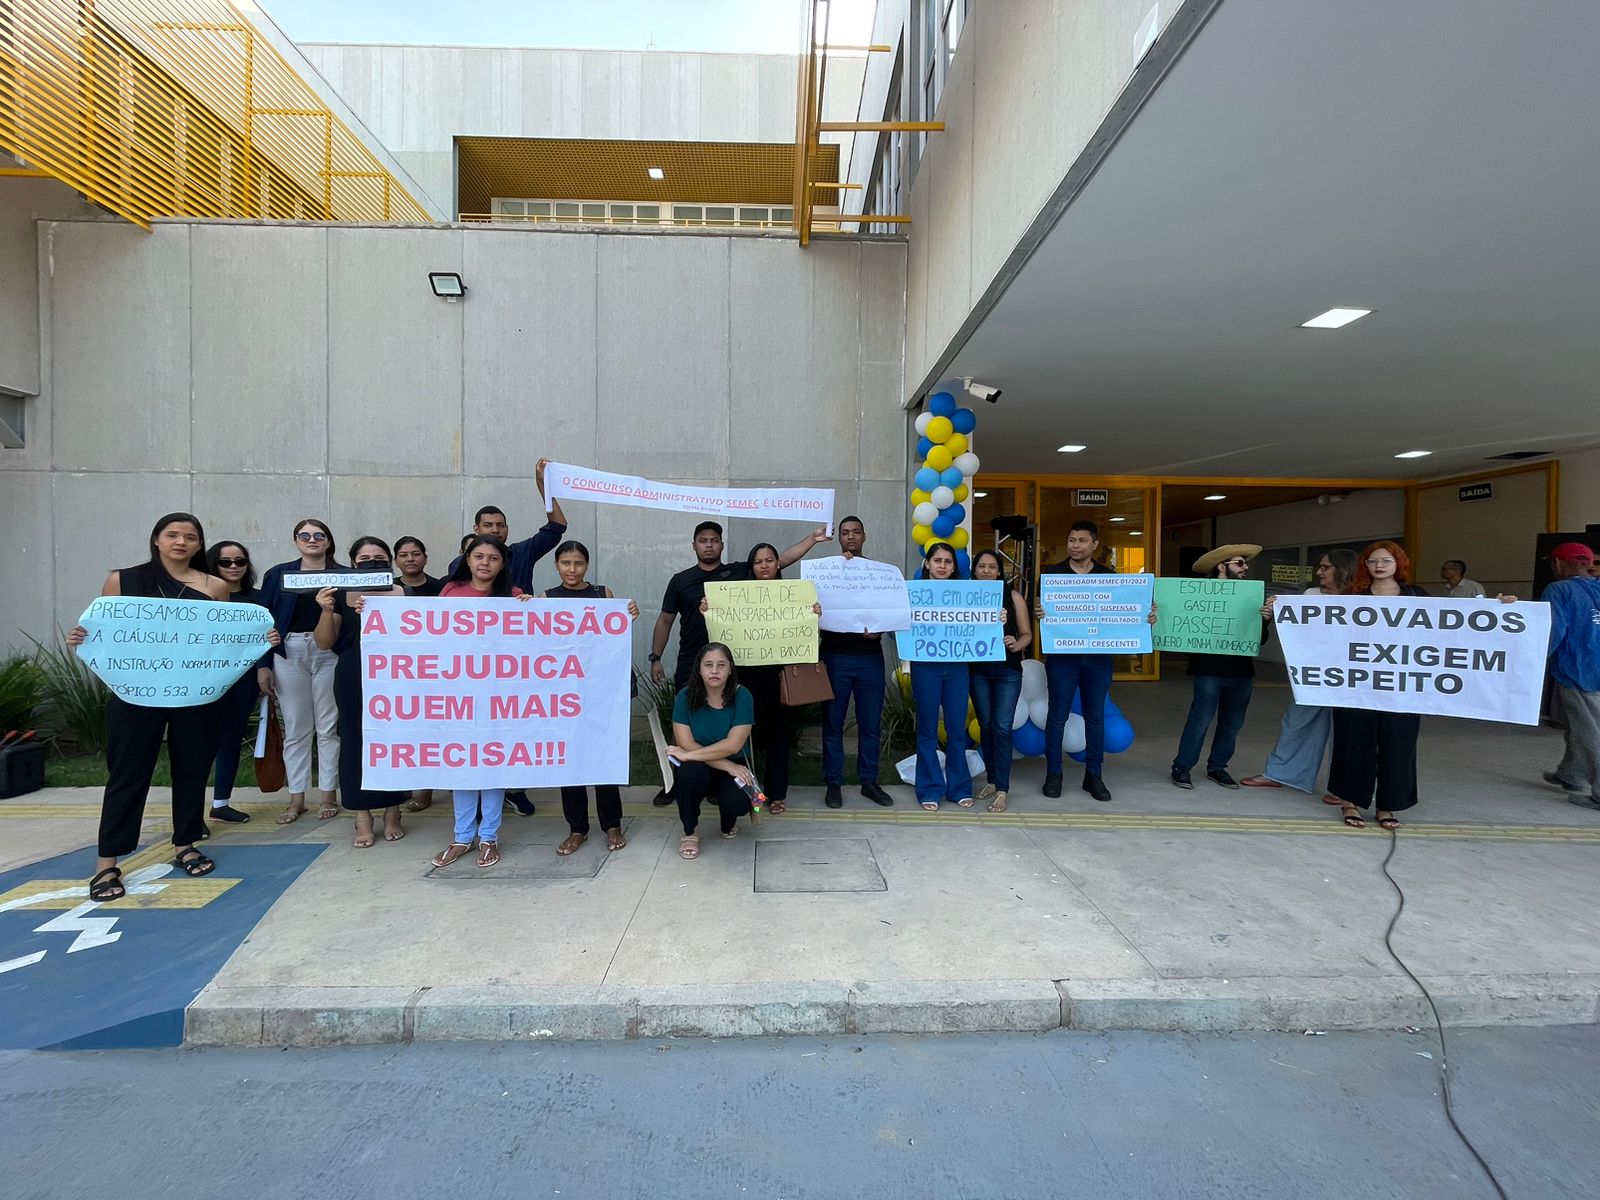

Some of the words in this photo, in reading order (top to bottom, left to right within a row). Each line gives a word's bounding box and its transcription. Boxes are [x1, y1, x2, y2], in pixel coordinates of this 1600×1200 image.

[562, 476, 570, 486] O
[572, 477, 632, 494] CONCURSO
[634, 488, 723, 506] ADMINISTRATIVO
[727, 499, 760, 507] SEMEC
[764, 498, 769, 507] É
[772, 498, 824, 509] LEGÍTIMO!
[780, 585, 798, 602] DE
[908, 587, 934, 605] ista
[942, 589, 962, 606] em
[966, 588, 1000, 606] ordem
[1180, 580, 1238, 595] ESTUDEI
[90, 602, 198, 622] PRECISAMOS
[207, 608, 268, 622] OBSERVAR:
[1184, 600, 1227, 612] GASTEI
[362, 610, 388, 635] A
[400, 606, 629, 636] SUSPENSÃO
[911, 610, 997, 622] ECRESCENTE
[1277, 605, 1526, 633] APROVADOS
[720, 629, 733, 640] AS
[744, 629, 776, 640] NOTAS
[782, 625, 812, 638] ESTÃO
[912, 623, 936, 636] não
[944, 624, 975, 636] muda
[1172, 616, 1237, 636] PASSEI
[92, 629, 102, 643] A
[113, 628, 178, 644] CLÁUSULA
[188, 633, 205, 644] DE
[1153, 635, 1182, 647] QUERO
[1187, 638, 1211, 650] MINHA
[1215, 639, 1259, 653] NOMEAÇÃO
[734, 648, 753, 659] SITE
[760, 648, 773, 659] DA
[780, 644, 814, 658] BANCA!
[914, 636, 997, 660] POSIÇÃO!
[1348, 642, 1506, 672] EXIGEM
[90, 658, 98, 669] A
[108, 656, 173, 672] INSTRUÇÃO
[368, 654, 585, 680] PREJUDICA
[109, 684, 156, 697] TÓPICO
[200, 686, 215, 696] DO
[368, 694, 474, 722] QUEM
[490, 693, 582, 720] MAIS
[369, 741, 566, 768] PRECISA!!!
